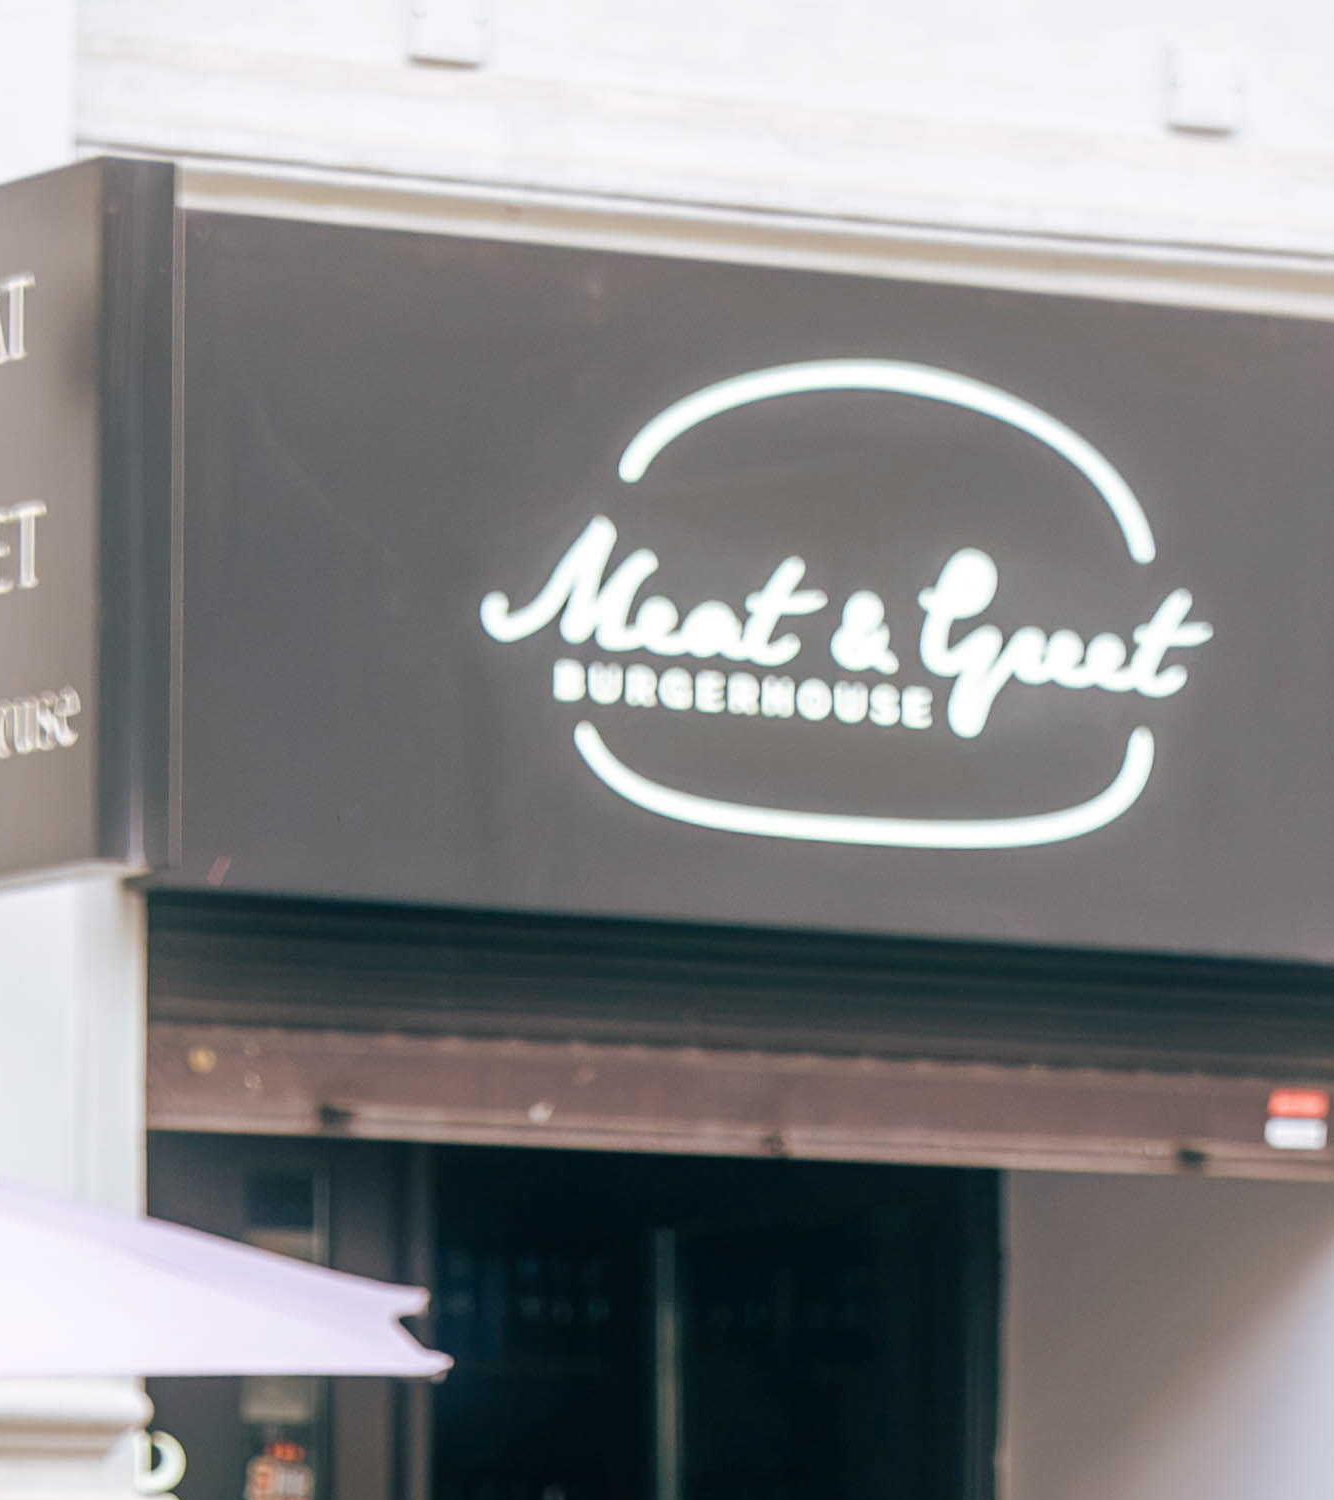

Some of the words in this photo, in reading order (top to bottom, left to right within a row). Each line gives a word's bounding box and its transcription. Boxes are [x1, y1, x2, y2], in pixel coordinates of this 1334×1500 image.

[480, 515, 829, 667] Meat
[831, 590, 900, 676] &
[918, 547, 1215, 739] Greet
[552, 657, 935, 730] BURGERHOUSE
